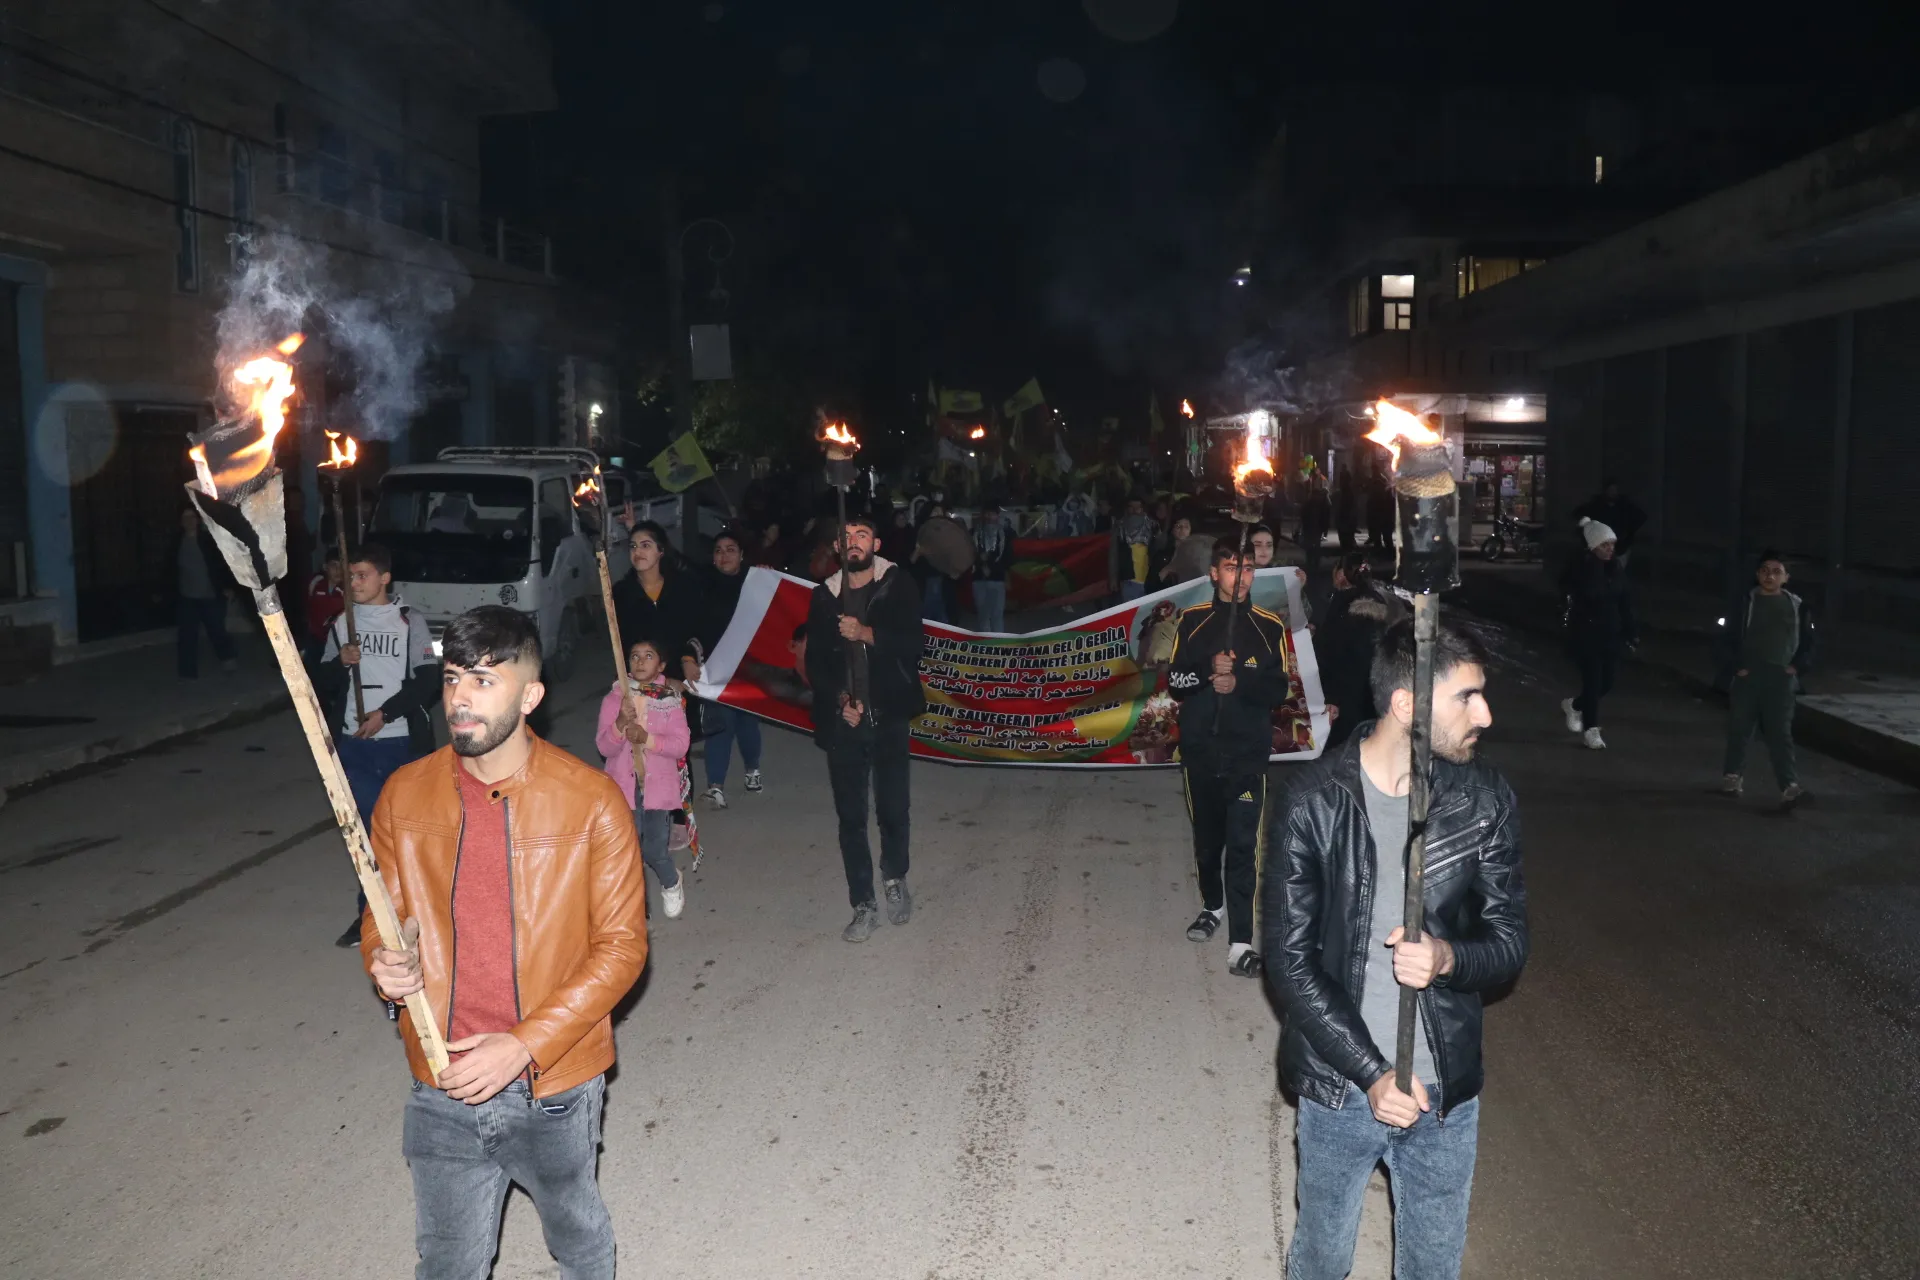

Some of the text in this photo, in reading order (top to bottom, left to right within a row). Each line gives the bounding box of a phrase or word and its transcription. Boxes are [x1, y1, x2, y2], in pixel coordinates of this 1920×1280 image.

[970, 645, 1050, 656] BERXWEDANA
[1053, 640, 1073, 654] GEL
[1086, 625, 1126, 648] GERÎLA
[1094, 642, 1128, 663] BIBÎN
[963, 672, 1018, 684] الشعوب
[1021, 671, 1067, 685] مقاومة
[956, 707, 1031, 728] SALVEGERA
[1033, 713, 1062, 728] PKK
[970, 736, 1016, 750] العمال
[1018, 740, 1051, 752] حزب
